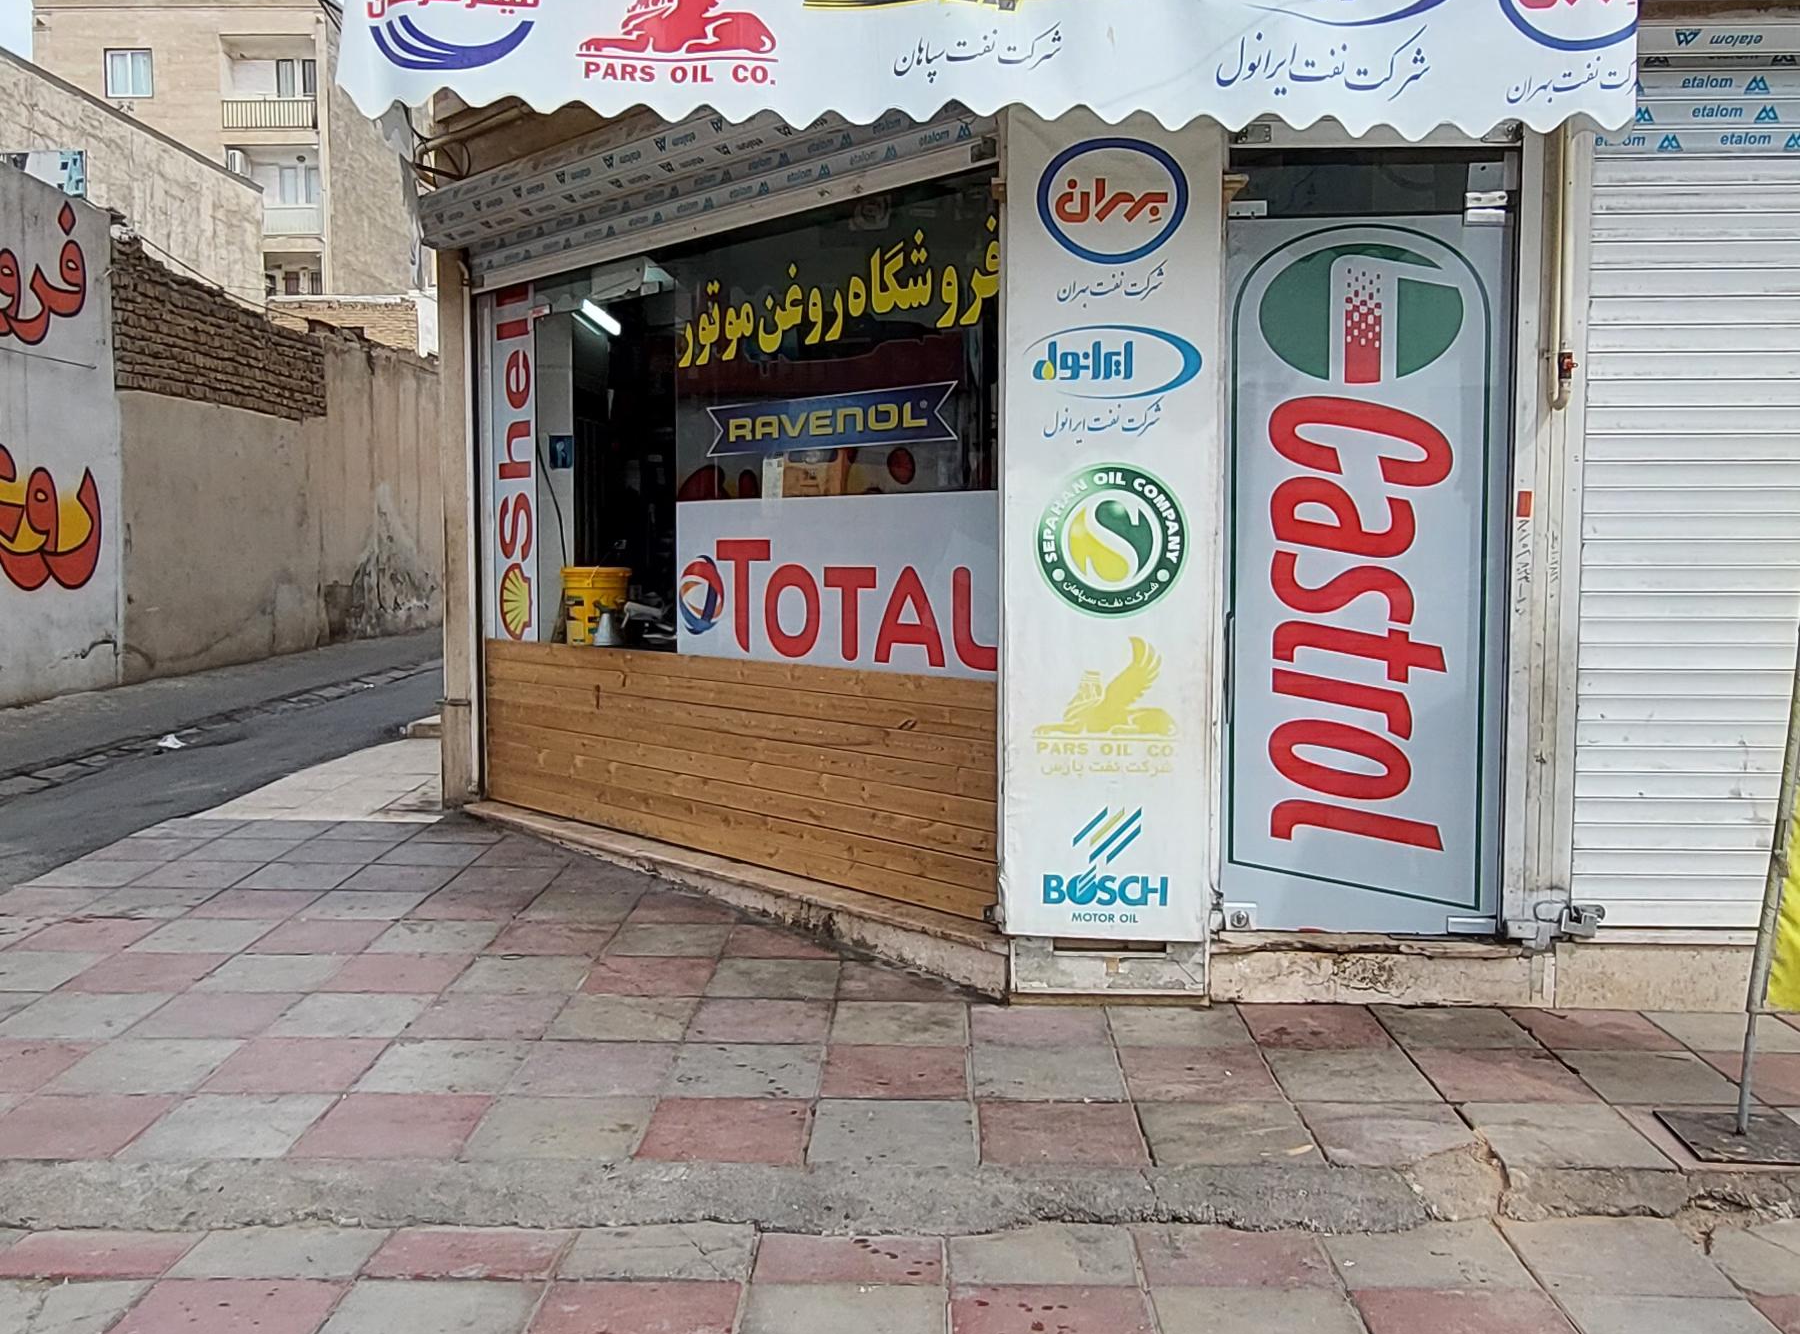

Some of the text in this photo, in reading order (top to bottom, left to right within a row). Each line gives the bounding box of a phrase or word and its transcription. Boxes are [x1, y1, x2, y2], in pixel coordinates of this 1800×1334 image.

[893, 21, 1062, 84] شرکت نفت سپاهان
[1216, 24, 1431, 102] شرکت نفت ایرانول
[583, 61, 777, 87] PARS OIL CO.
[1506, 74, 1554, 104] بهران
[1552, 55, 1601, 93] نفت
[1681, 74, 1734, 89] etalom
[1691, 105, 1744, 118] etalom
[1719, 132, 1772, 146] etalom
[1055, 177, 1169, 224] بهران
[678, 215, 1000, 367] فروشگاه روغن موتور
[1056, 259, 1168, 308] شرکت نفت بهران
[1032, 340, 1134, 381] ایرانول
[728, 402, 928, 443] RAVENOL
[1043, 396, 1165, 445] شرکت نفت ایرانول
[1042, 471, 1181, 564] SEPAHAN OIL COMPANY
[716, 539, 998, 672] TOTAL
[1062, 579, 1160, 608] شرکت نفت سپاهان
[1267, 395, 1454, 853] Castrol
[1036, 740, 1089, 756] PARS
[1100, 742, 1133, 757] OIL
[1088, 760, 1121, 773] نفت
[1125, 759, 1173, 777] شرکت
[1042, 872, 1168, 908] BOSCH
[1071, 911, 1139, 924] MOTOR OIL
